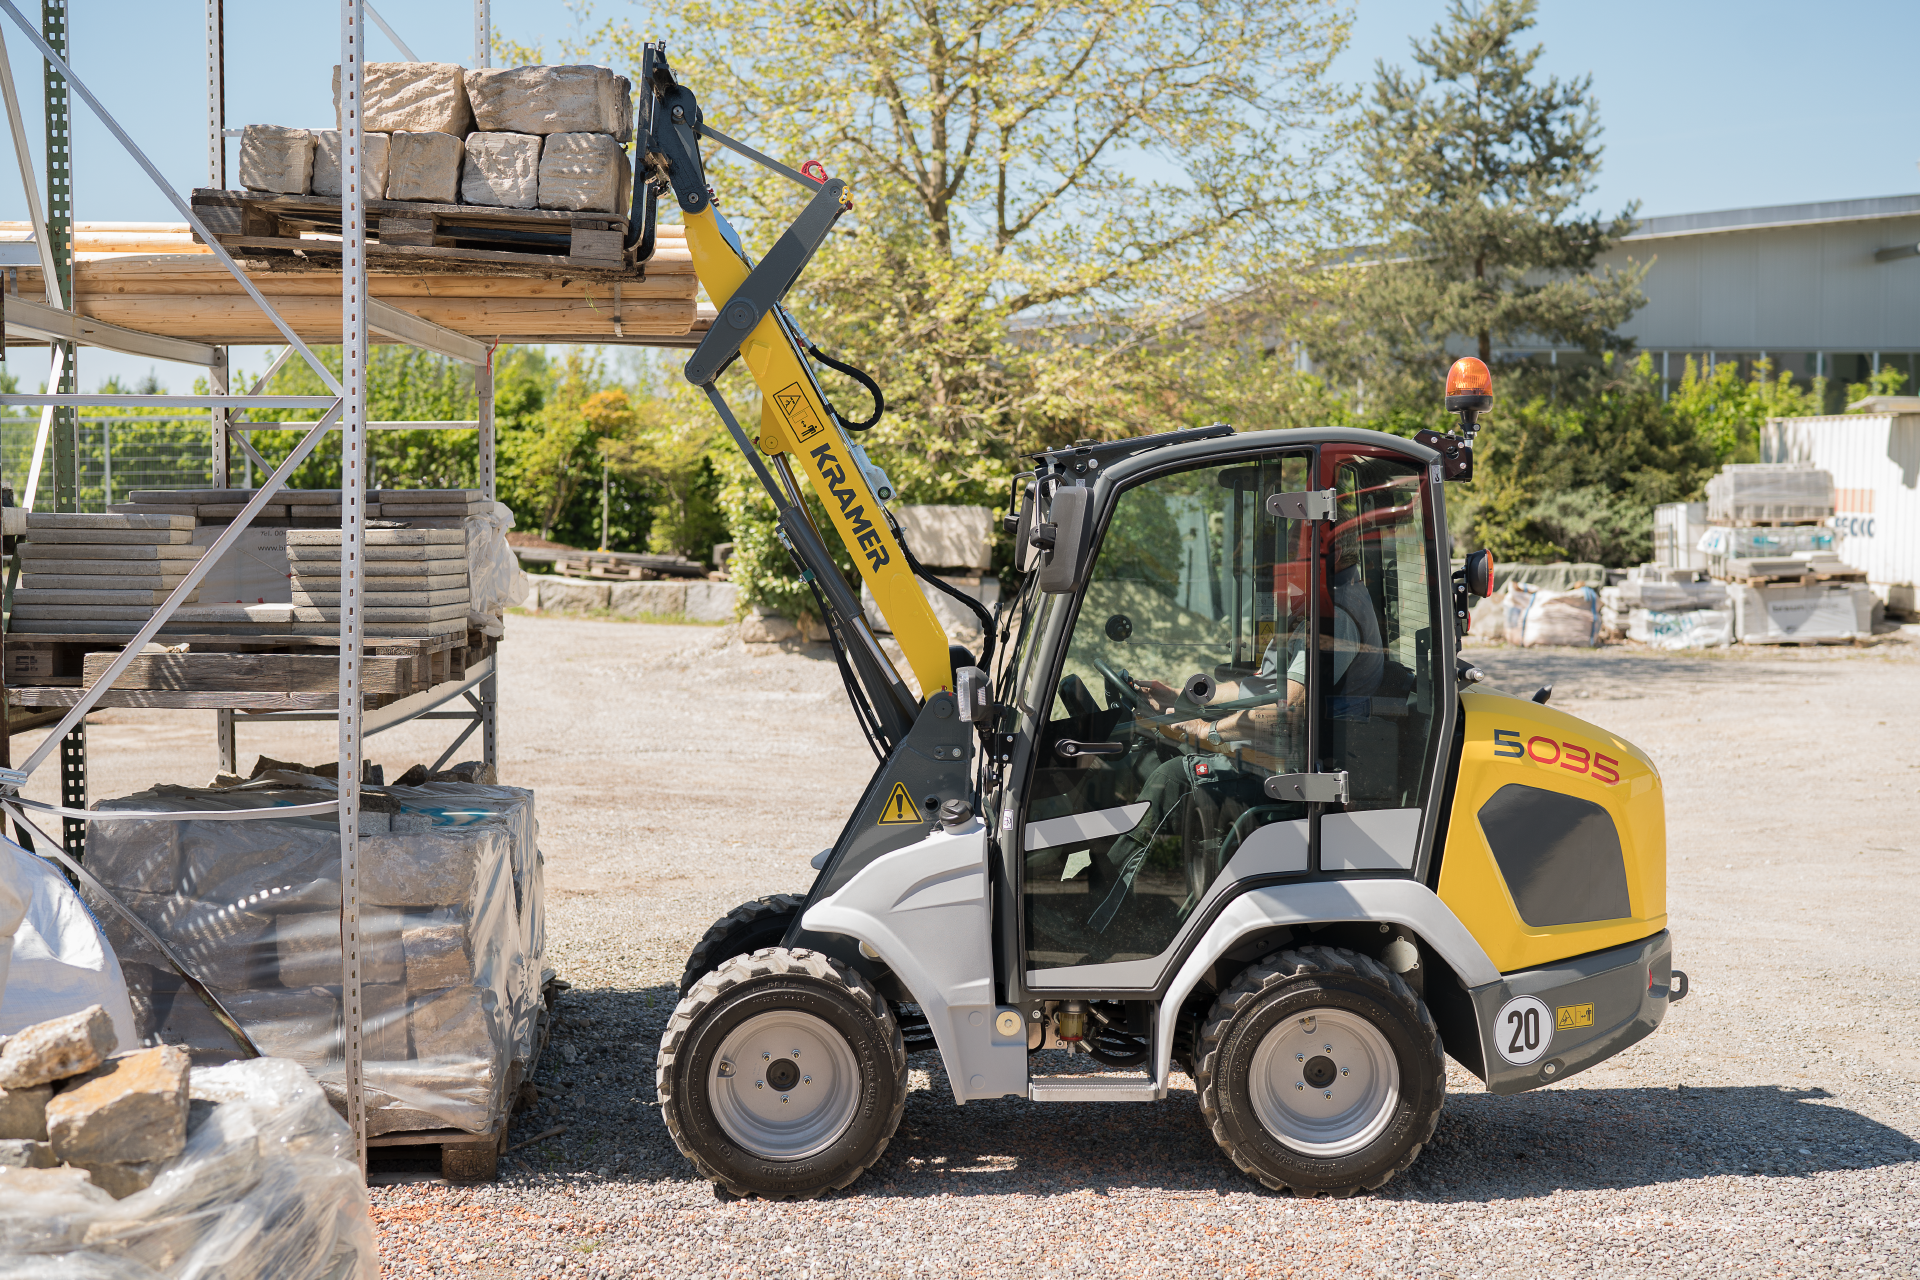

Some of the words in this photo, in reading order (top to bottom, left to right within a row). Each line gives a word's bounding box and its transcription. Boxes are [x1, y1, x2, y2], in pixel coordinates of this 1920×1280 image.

[810, 442, 890, 573] KRAMER
[1494, 728, 1620, 786] 5035
[1507, 1007, 1541, 1054] 20
